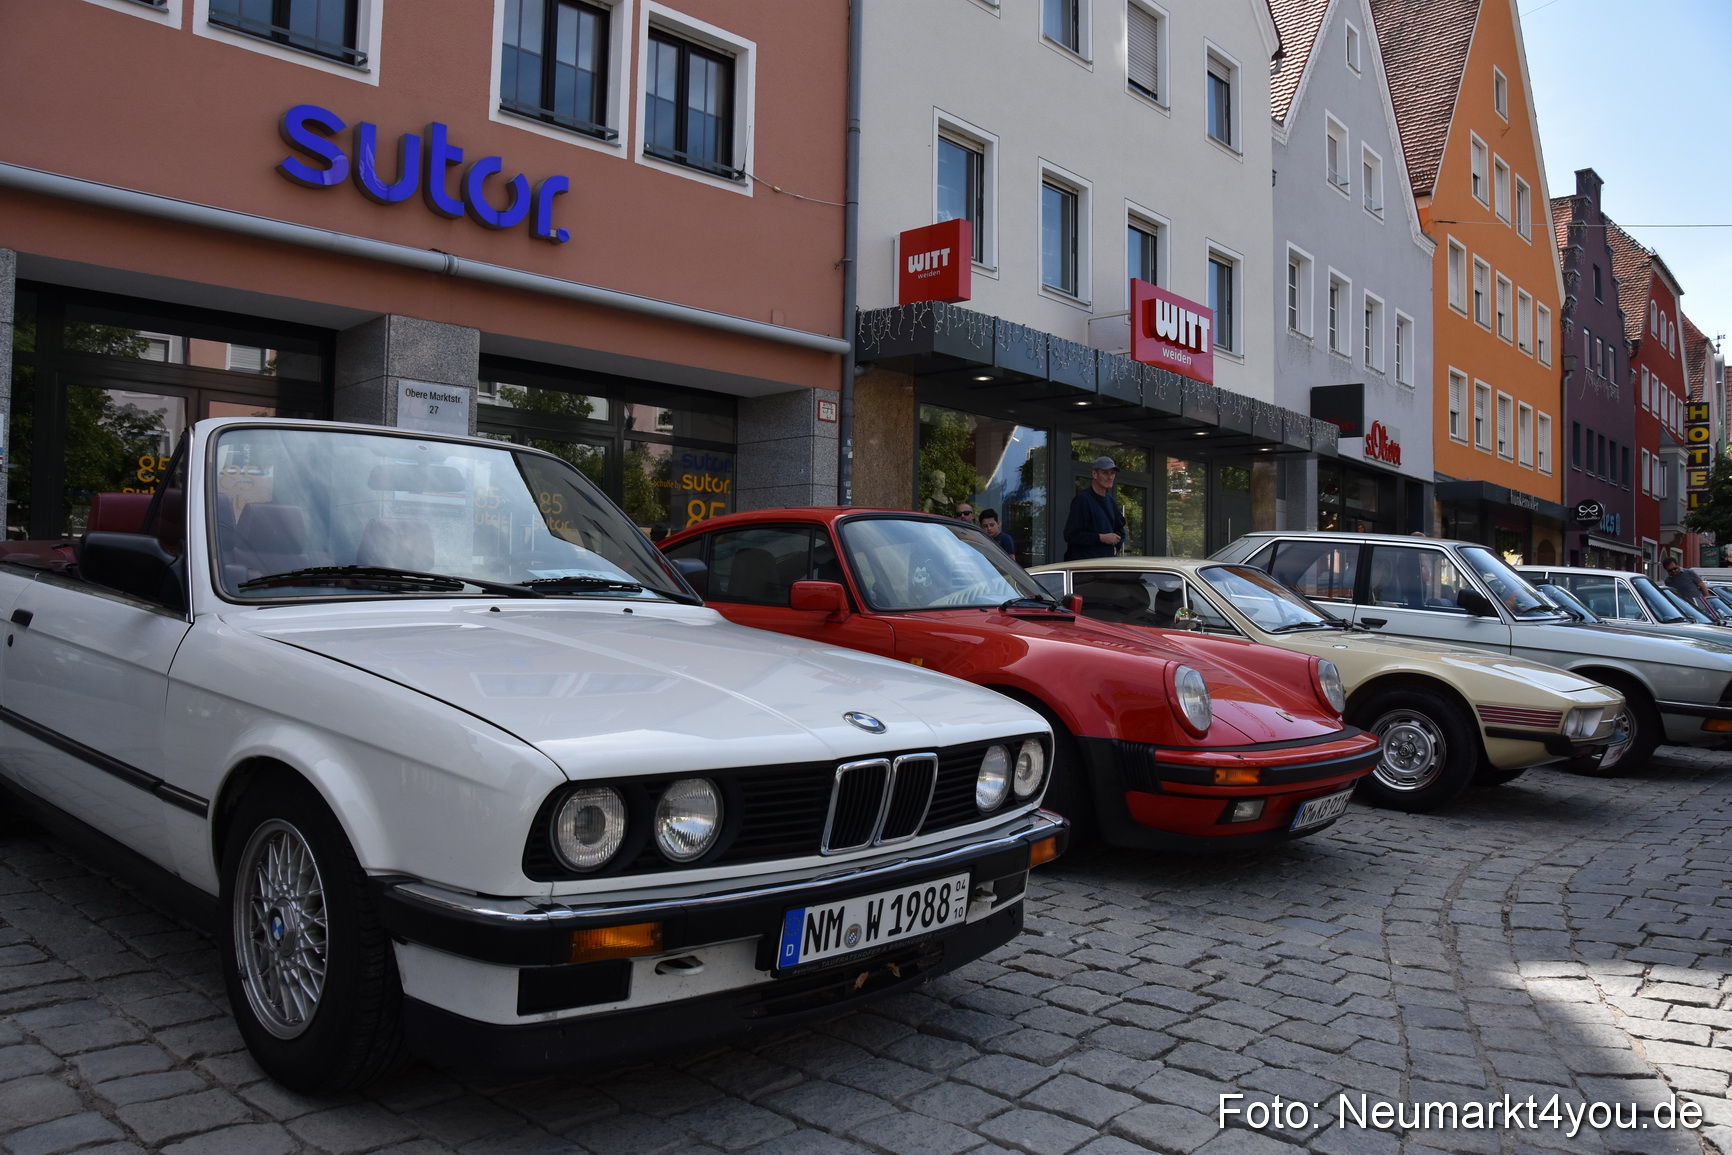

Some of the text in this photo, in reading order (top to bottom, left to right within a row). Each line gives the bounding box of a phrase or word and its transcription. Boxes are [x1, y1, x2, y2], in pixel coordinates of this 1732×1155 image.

[276, 104, 571, 244] sutor.
[907, 248, 950, 274] WITT
[917, 268, 941, 279] weiden
[1153, 298, 1210, 353] WITT
[1162, 346, 1193, 366] weiden
[405, 387, 463, 404] Obere Marktstr.
[429, 405, 439, 414] 27
[1689, 405, 1709, 509] HOTEL
[682, 473, 731, 494] sutor.
[540, 492, 563, 514] 85
[955, 878, 966, 892] 04
[785, 883, 951, 957] D NM W 1988
[953, 906, 964, 919] 10
